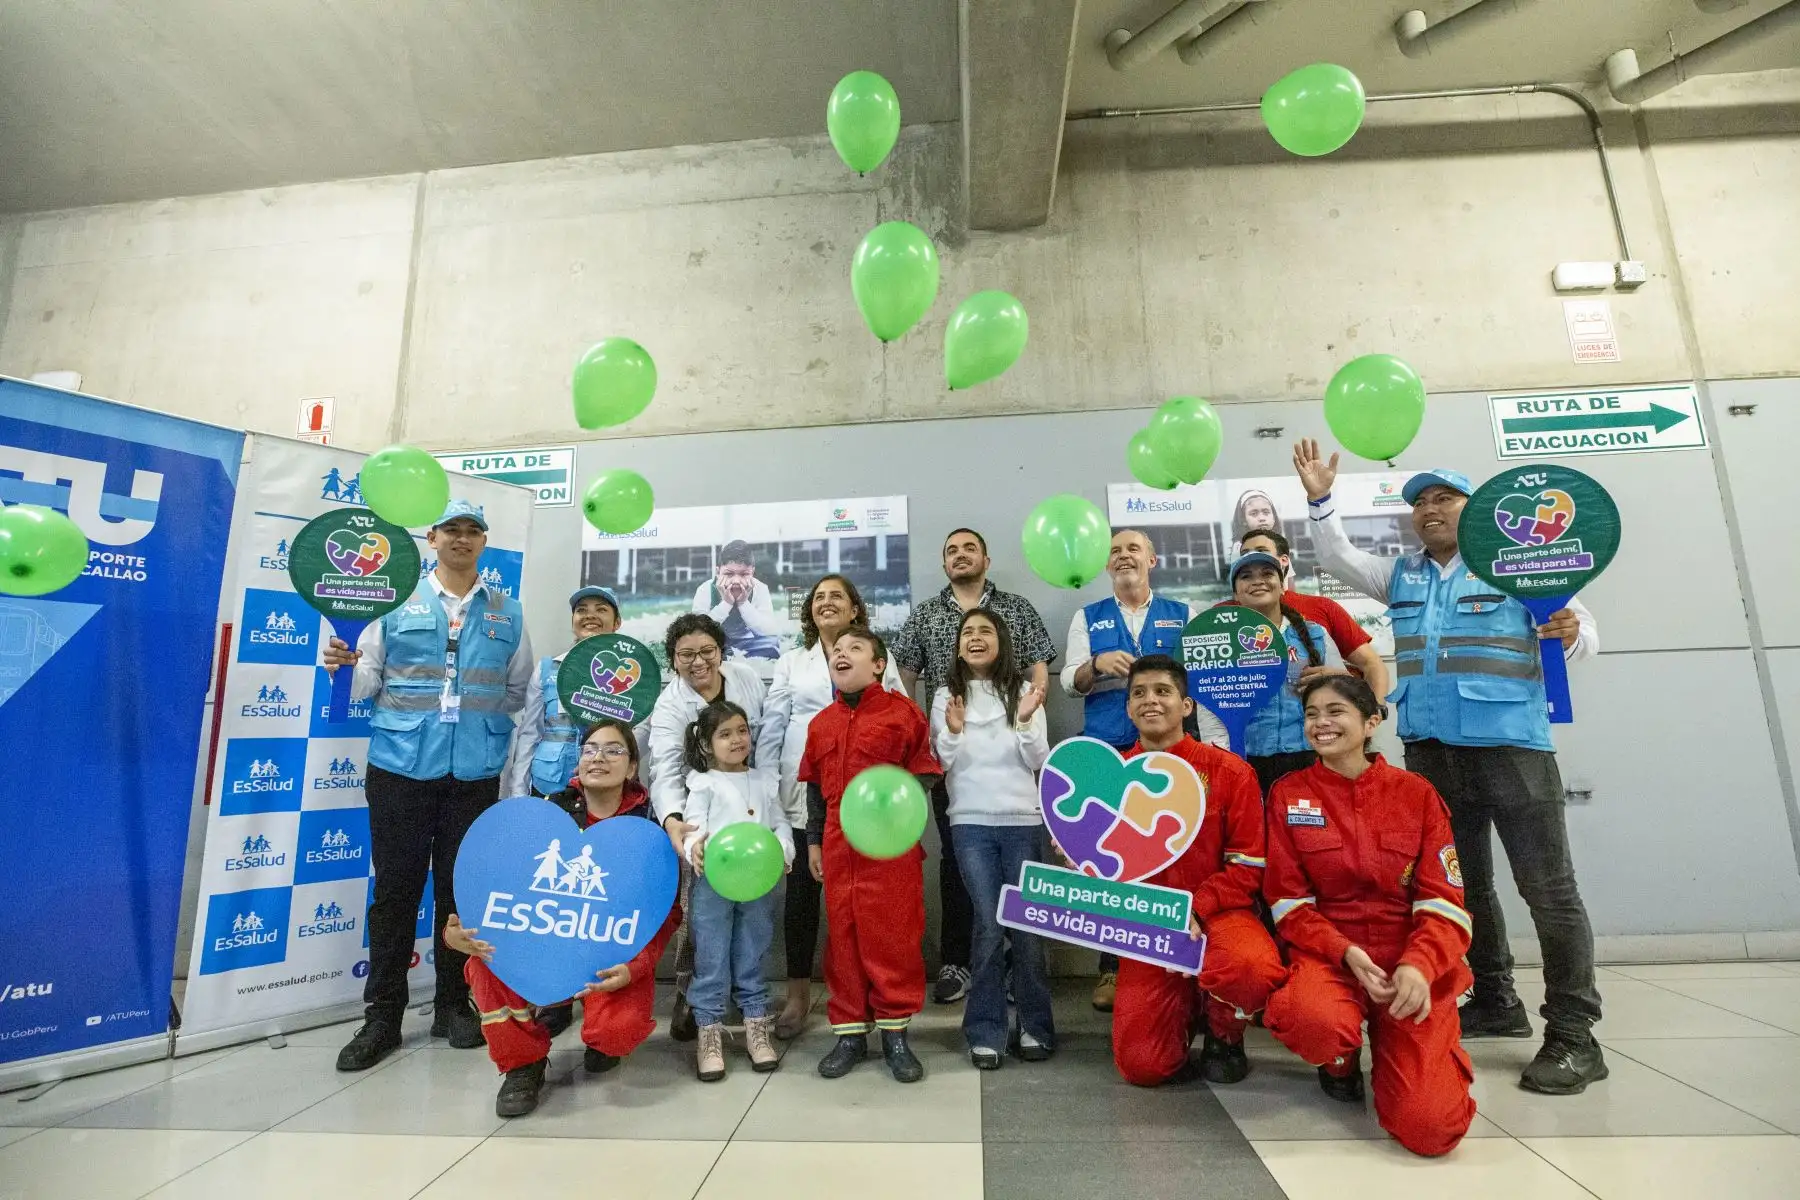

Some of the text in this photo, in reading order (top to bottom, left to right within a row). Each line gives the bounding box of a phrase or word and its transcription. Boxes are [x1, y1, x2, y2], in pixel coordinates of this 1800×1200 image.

[1577, 351, 1616, 359] EMERGENCIA
[1516, 396, 1621, 414] RUTA DE
[1505, 431, 1649, 452] EVACUACION
[461, 454, 551, 471] RUTA DE
[1149, 500, 1192, 512] EsSalud
[89, 551, 147, 567] PORTE
[1503, 553, 1522, 561] Una
[1523, 549, 1549, 560] parte
[1550, 547, 1562, 555] de
[1505, 563, 1517, 571] es
[1518, 561, 1541, 570] vida
[1542, 559, 1567, 569] para
[342, 579, 364, 587] parte
[1533, 577, 1568, 587] EsSalud
[337, 587, 355, 595] vida
[356, 589, 376, 597] para
[346, 603, 374, 612] EsSalud
[249, 630, 309, 646] EsSalud
[1183, 644, 1233, 661] FOTO
[1248, 673, 1267, 682] julio
[1198, 682, 1268, 693] ESTACIÓN CENTRAL
[1241, 690, 1256, 698] sur)
[241, 704, 301, 718] EsSalud
[602, 705, 618, 714] para
[232, 778, 294, 794] EsSalud
[225, 852, 286, 871] EsSalud
[305, 845, 362, 863] EsSalud
[1028, 876, 1182, 922] Una parte de mí,
[481, 891, 641, 945] EsSalud
[298, 917, 356, 938] EsSalud
[1024, 906, 1175, 955] es vida para ti.
[214, 928, 278, 951] EsSalud
[237, 969, 343, 995] www.essalud.gob.pe
[105, 1008, 150, 1023] /ATUPeru
[0, 1025, 58, 1040] U.GobPeru
